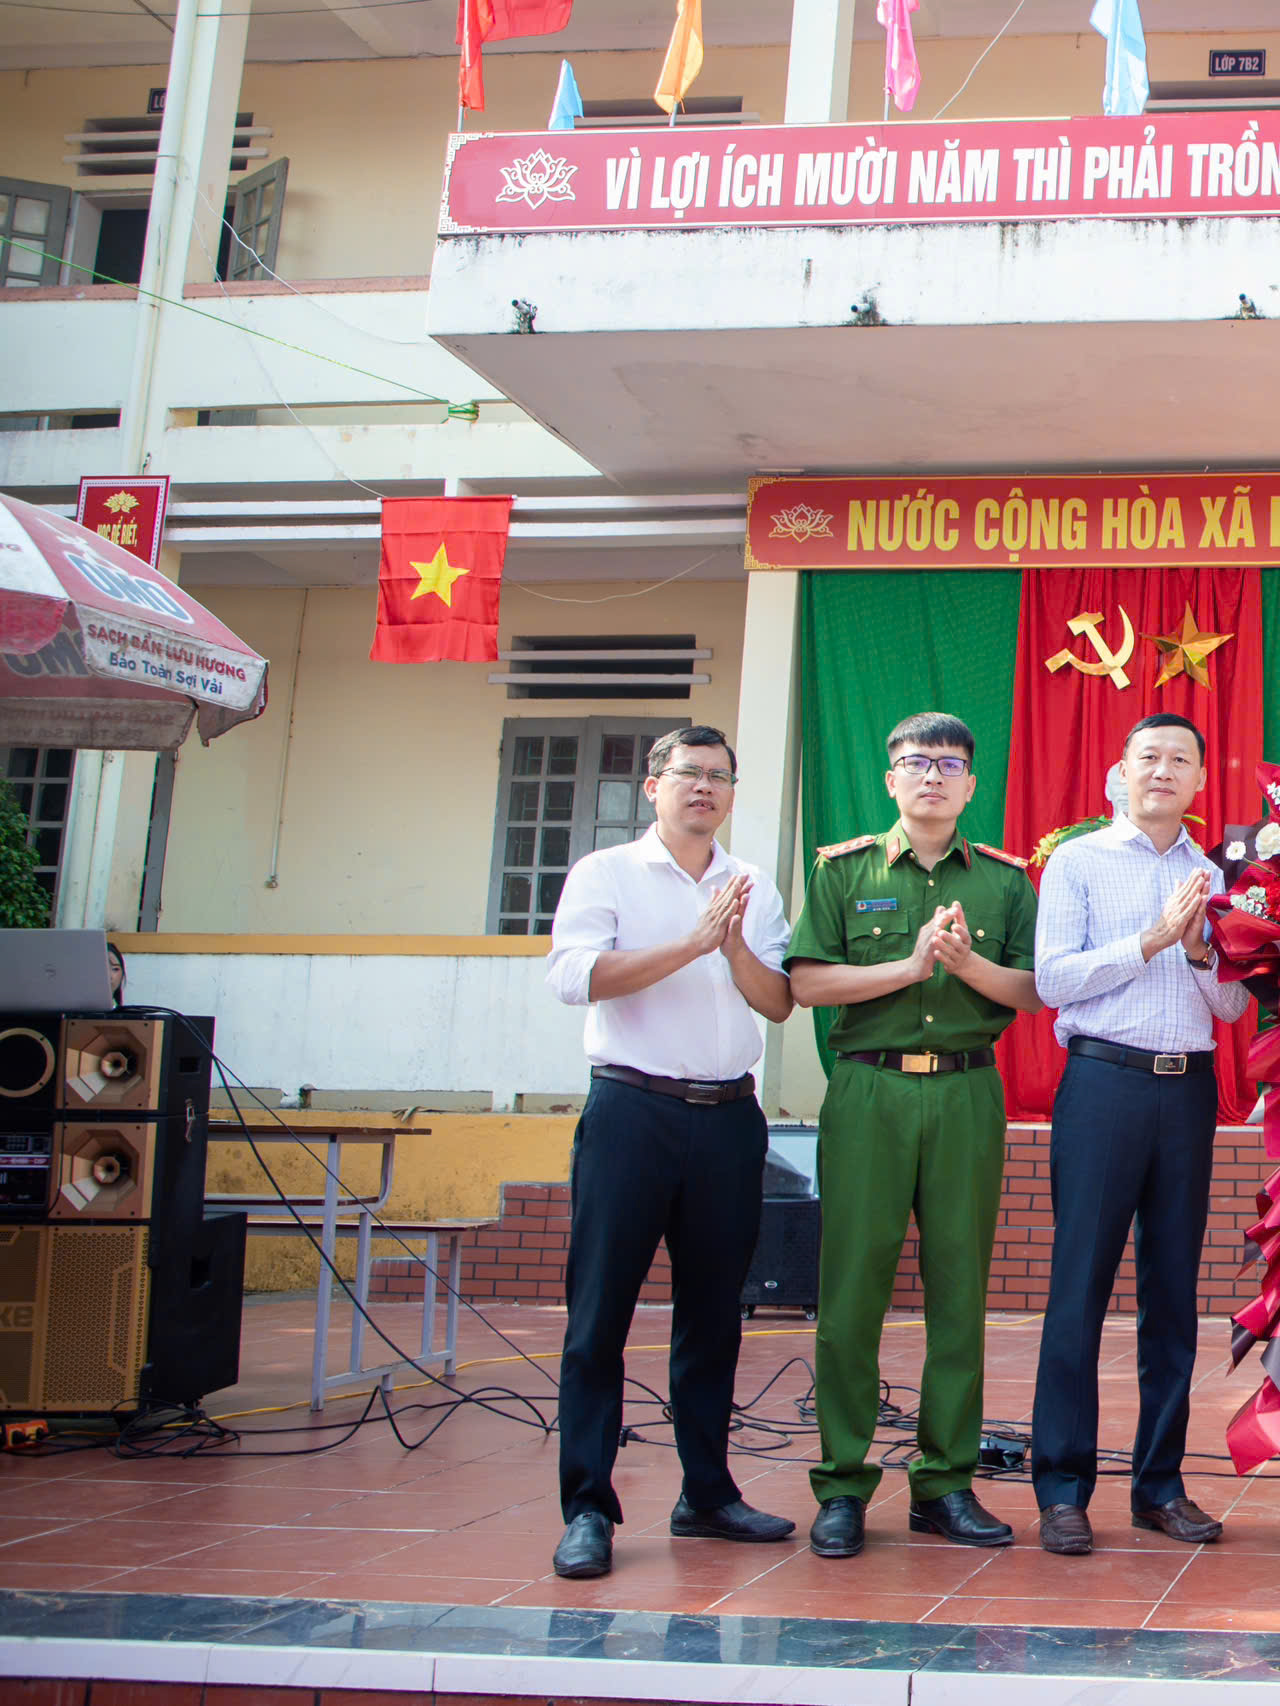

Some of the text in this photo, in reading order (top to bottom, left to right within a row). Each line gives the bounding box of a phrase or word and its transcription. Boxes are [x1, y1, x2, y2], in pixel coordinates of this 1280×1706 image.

[1215, 54, 1260, 71] LỚP 7B2
[606, 136, 641, 210] VÌ
[650, 151, 711, 219] LỢI
[719, 139, 783, 207] ÍCH
[794, 135, 898, 207] MƯỜI
[909, 138, 999, 203] NĂM
[1012, 135, 1073, 201] THÌ
[1083, 125, 1174, 200] PHẢI
[847, 488, 959, 552] NƯỚC
[973, 487, 1087, 562] CỘNG
[1102, 485, 1186, 549] HÒA
[1198, 485, 1256, 548] XÃ
[109, 651, 223, 695] Bảo Toàn Sợi Vải
[195, 657, 248, 682] HƯƠNG
